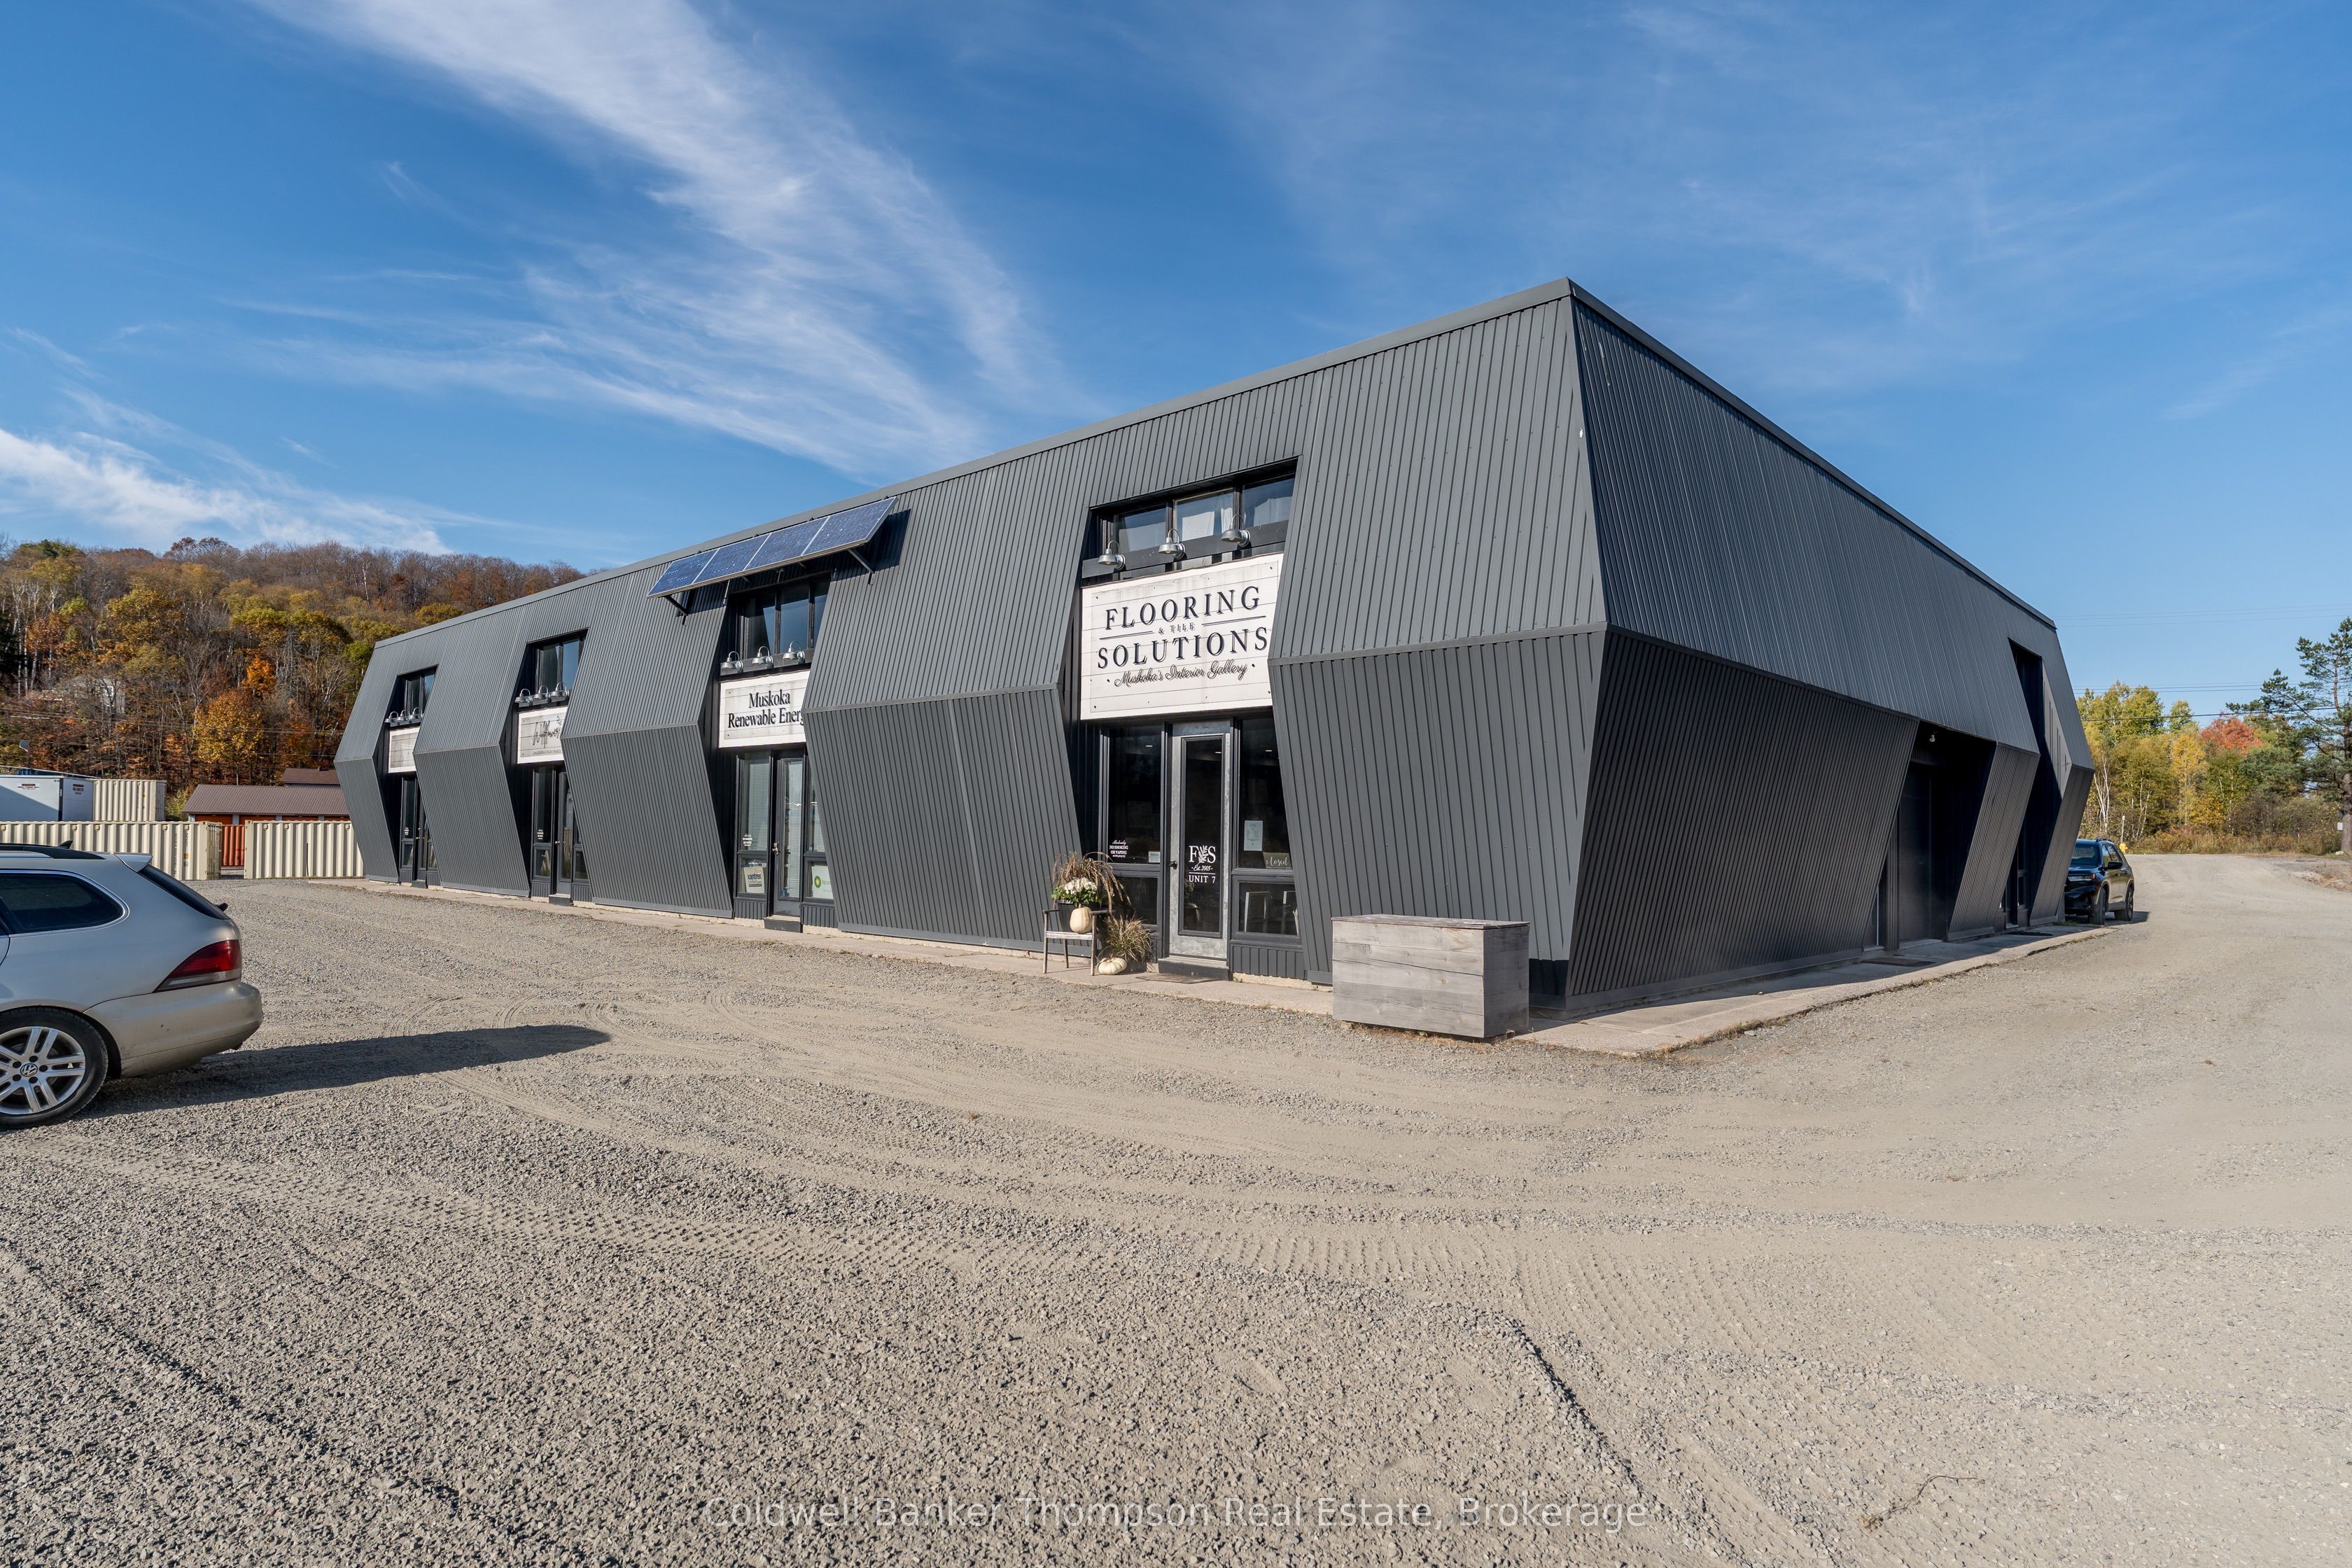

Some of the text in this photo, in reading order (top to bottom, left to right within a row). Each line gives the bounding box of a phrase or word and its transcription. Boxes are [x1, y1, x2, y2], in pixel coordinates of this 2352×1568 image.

[1105, 586, 1260, 630] FLOORING
[1170, 622, 1196, 634] TILE
[1098, 626, 1268, 669] SOLUTIONS
[1114, 659, 1248, 687] Muskoka's Interior Gallery
[748, 689, 790, 708] Muskoka
[728, 708, 776, 728] Renewable
[1266, 856, 1288, 867] closed
